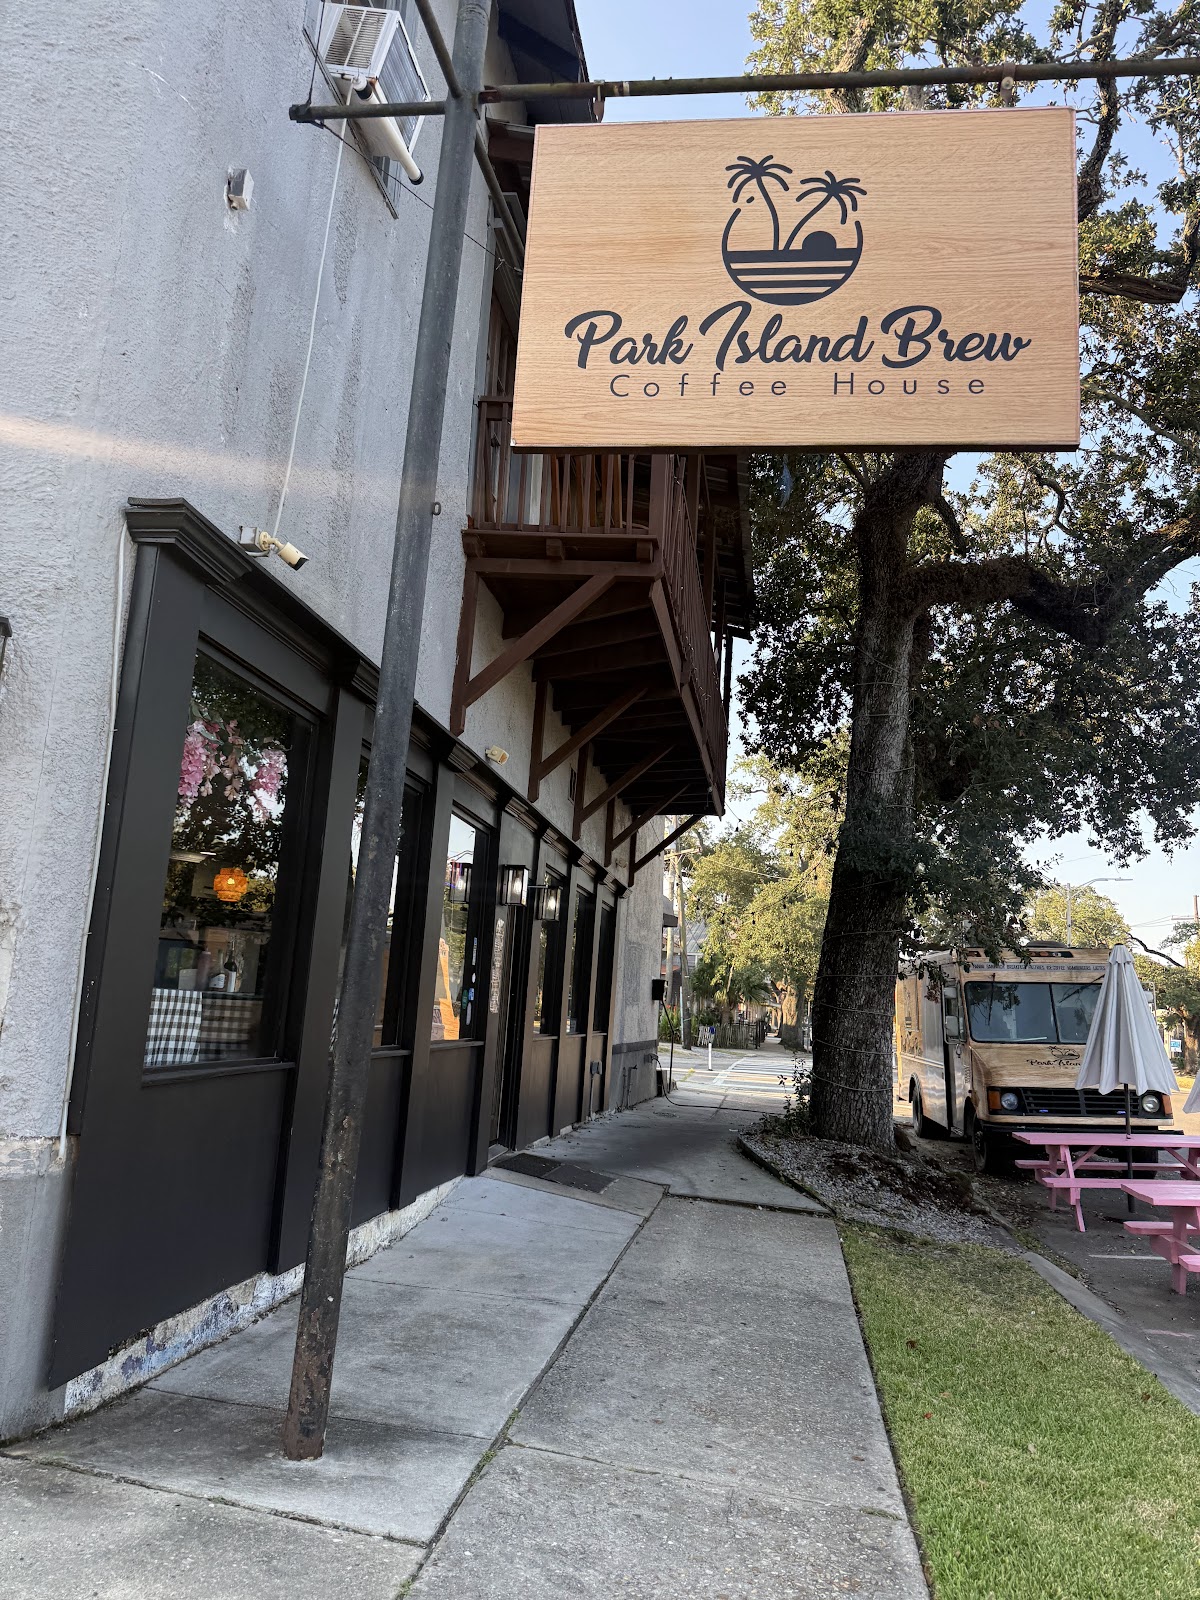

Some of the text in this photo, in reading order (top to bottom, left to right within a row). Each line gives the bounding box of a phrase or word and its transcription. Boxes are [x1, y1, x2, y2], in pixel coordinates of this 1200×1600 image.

[564, 300, 1033, 372] Park Island Brew
[609, 372, 986, 398] Coffee House
[1026, 1059, 1081, 1067] Park Islan
